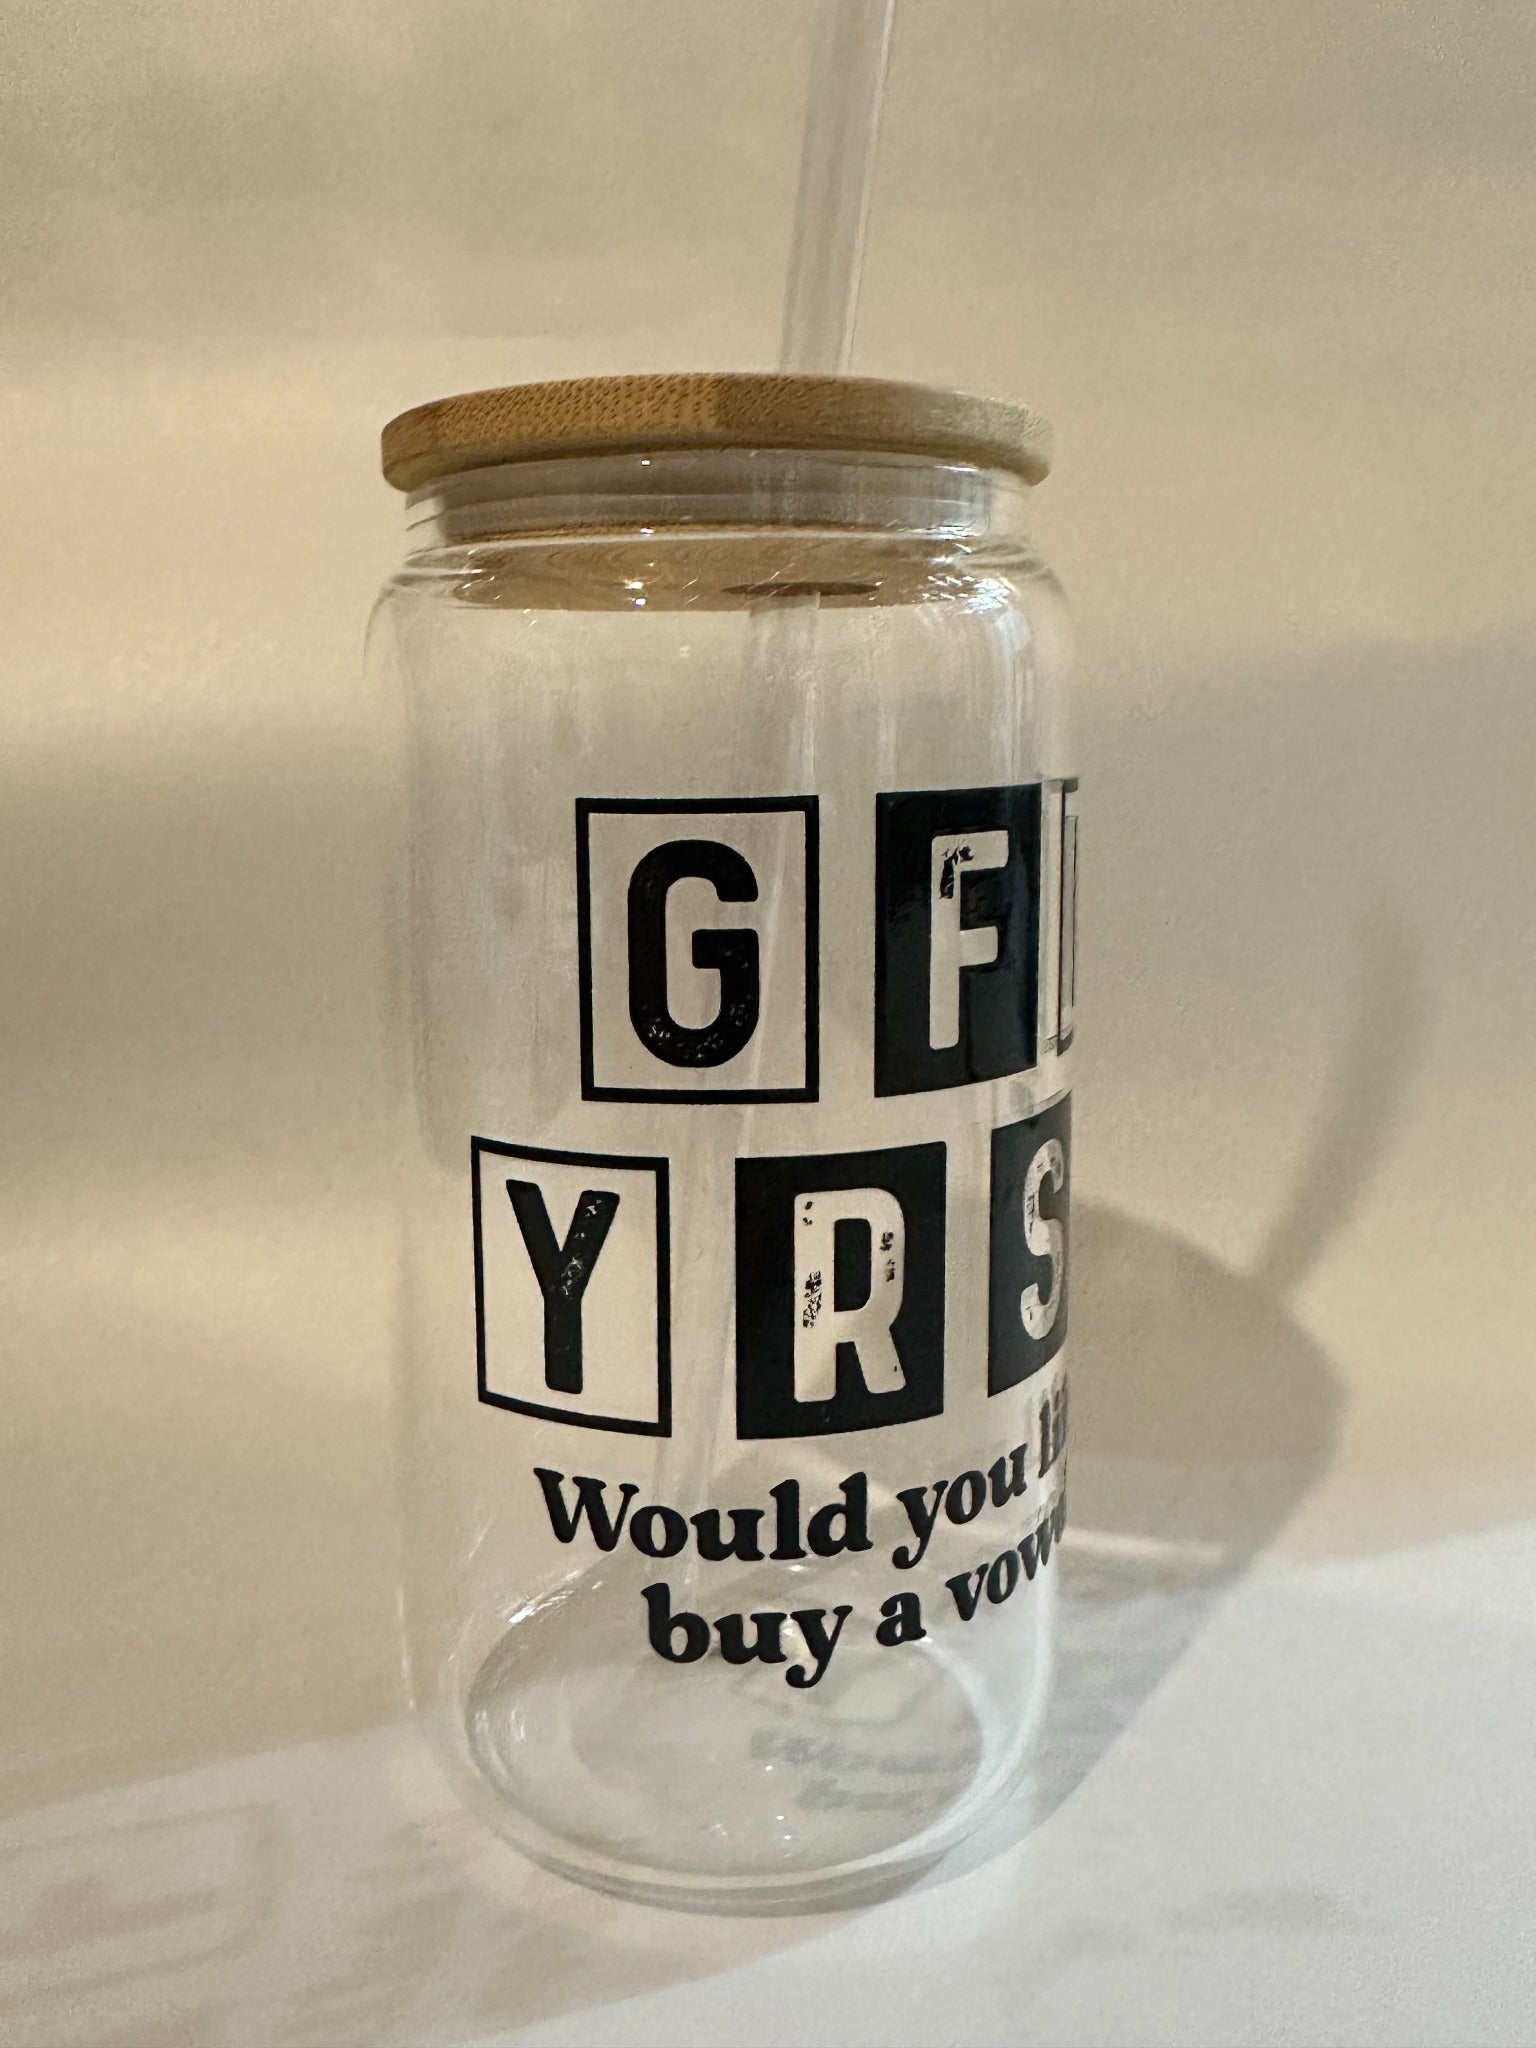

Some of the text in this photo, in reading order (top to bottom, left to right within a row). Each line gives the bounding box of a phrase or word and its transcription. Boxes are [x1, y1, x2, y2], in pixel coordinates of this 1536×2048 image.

[627, 830, 1010, 1068] G F
[505, 1138, 1064, 1403] Y R S
[534, 1467, 874, 1561] Would
[892, 1442, 1028, 1570] you
[641, 1583, 853, 1688] buy
[876, 1592, 927, 1647] a
